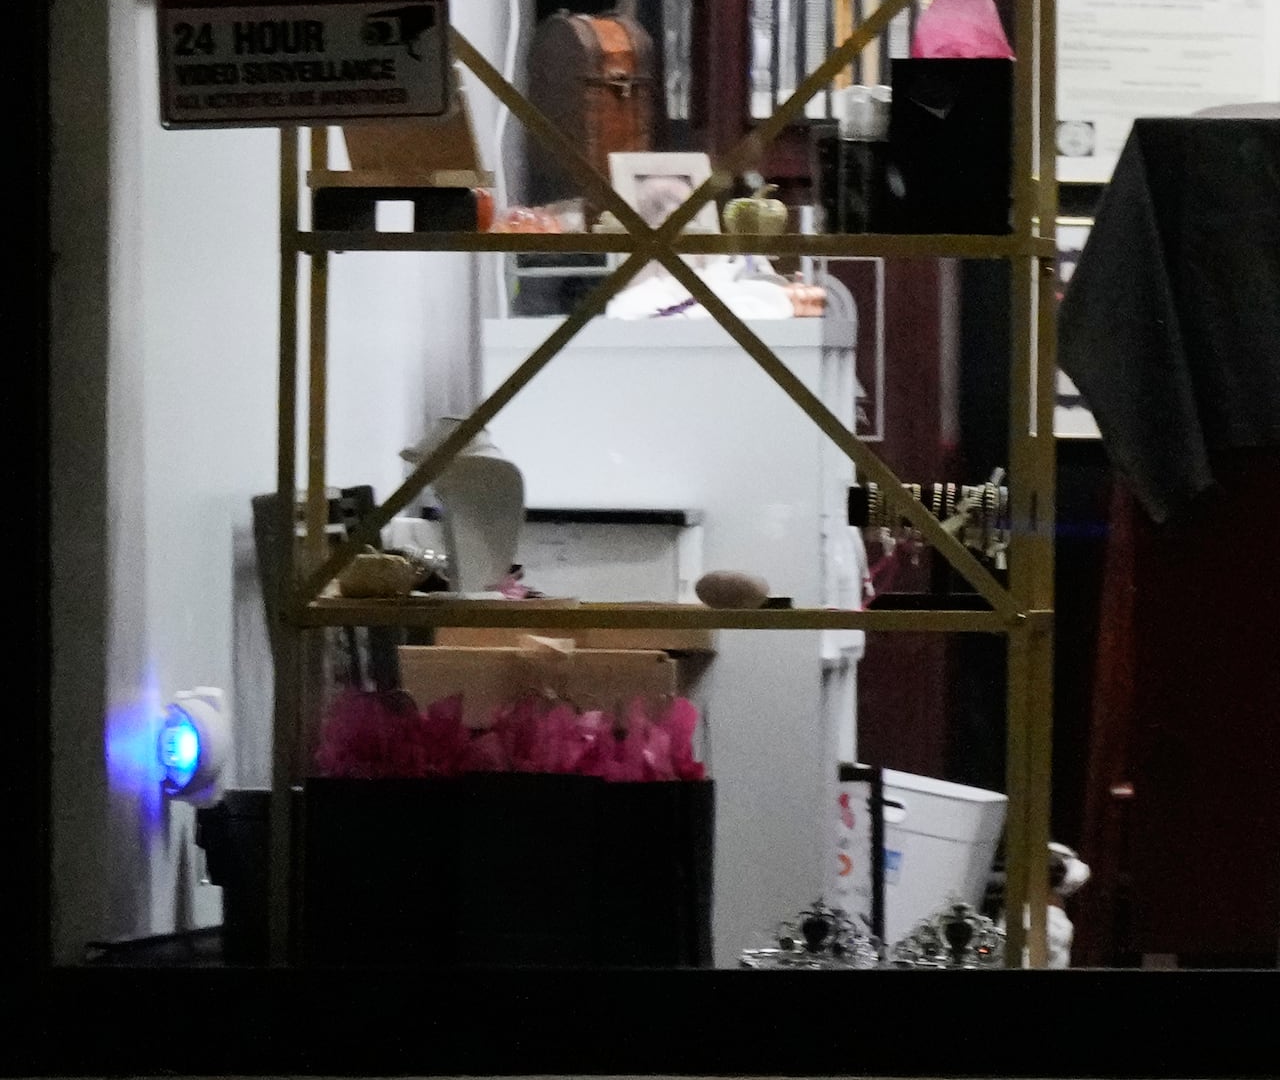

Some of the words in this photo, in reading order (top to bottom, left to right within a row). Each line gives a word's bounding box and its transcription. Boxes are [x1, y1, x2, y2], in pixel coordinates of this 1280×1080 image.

[173, 22, 215, 57] 24
[232, 20, 325, 55] HOUR
[175, 62, 237, 86] VIDEO
